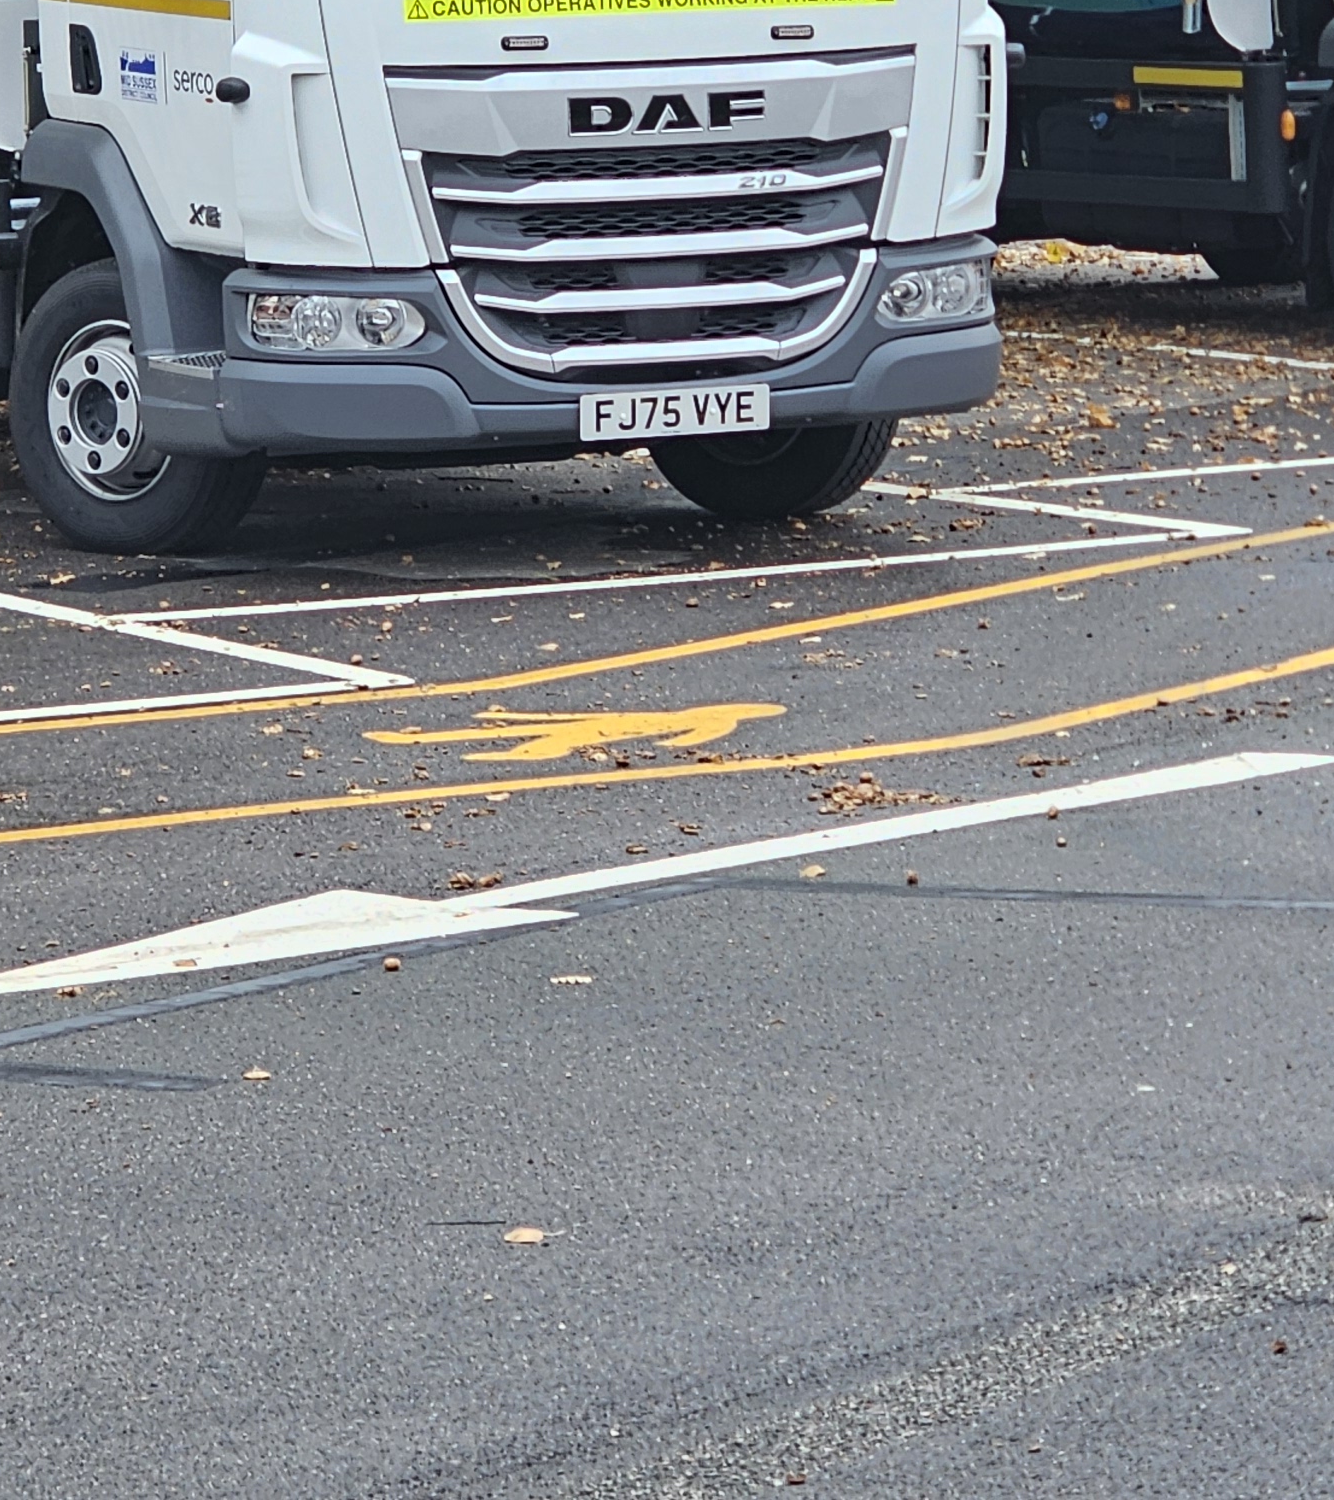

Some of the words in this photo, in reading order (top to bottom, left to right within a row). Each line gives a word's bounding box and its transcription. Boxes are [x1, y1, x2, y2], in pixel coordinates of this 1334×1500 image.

[173, 69, 214, 95] serco
[567, 89, 766, 137] DAF
[738, 174, 786, 188] 210
[595, 395, 682, 433] FJ75
[692, 391, 755, 426] VYE
